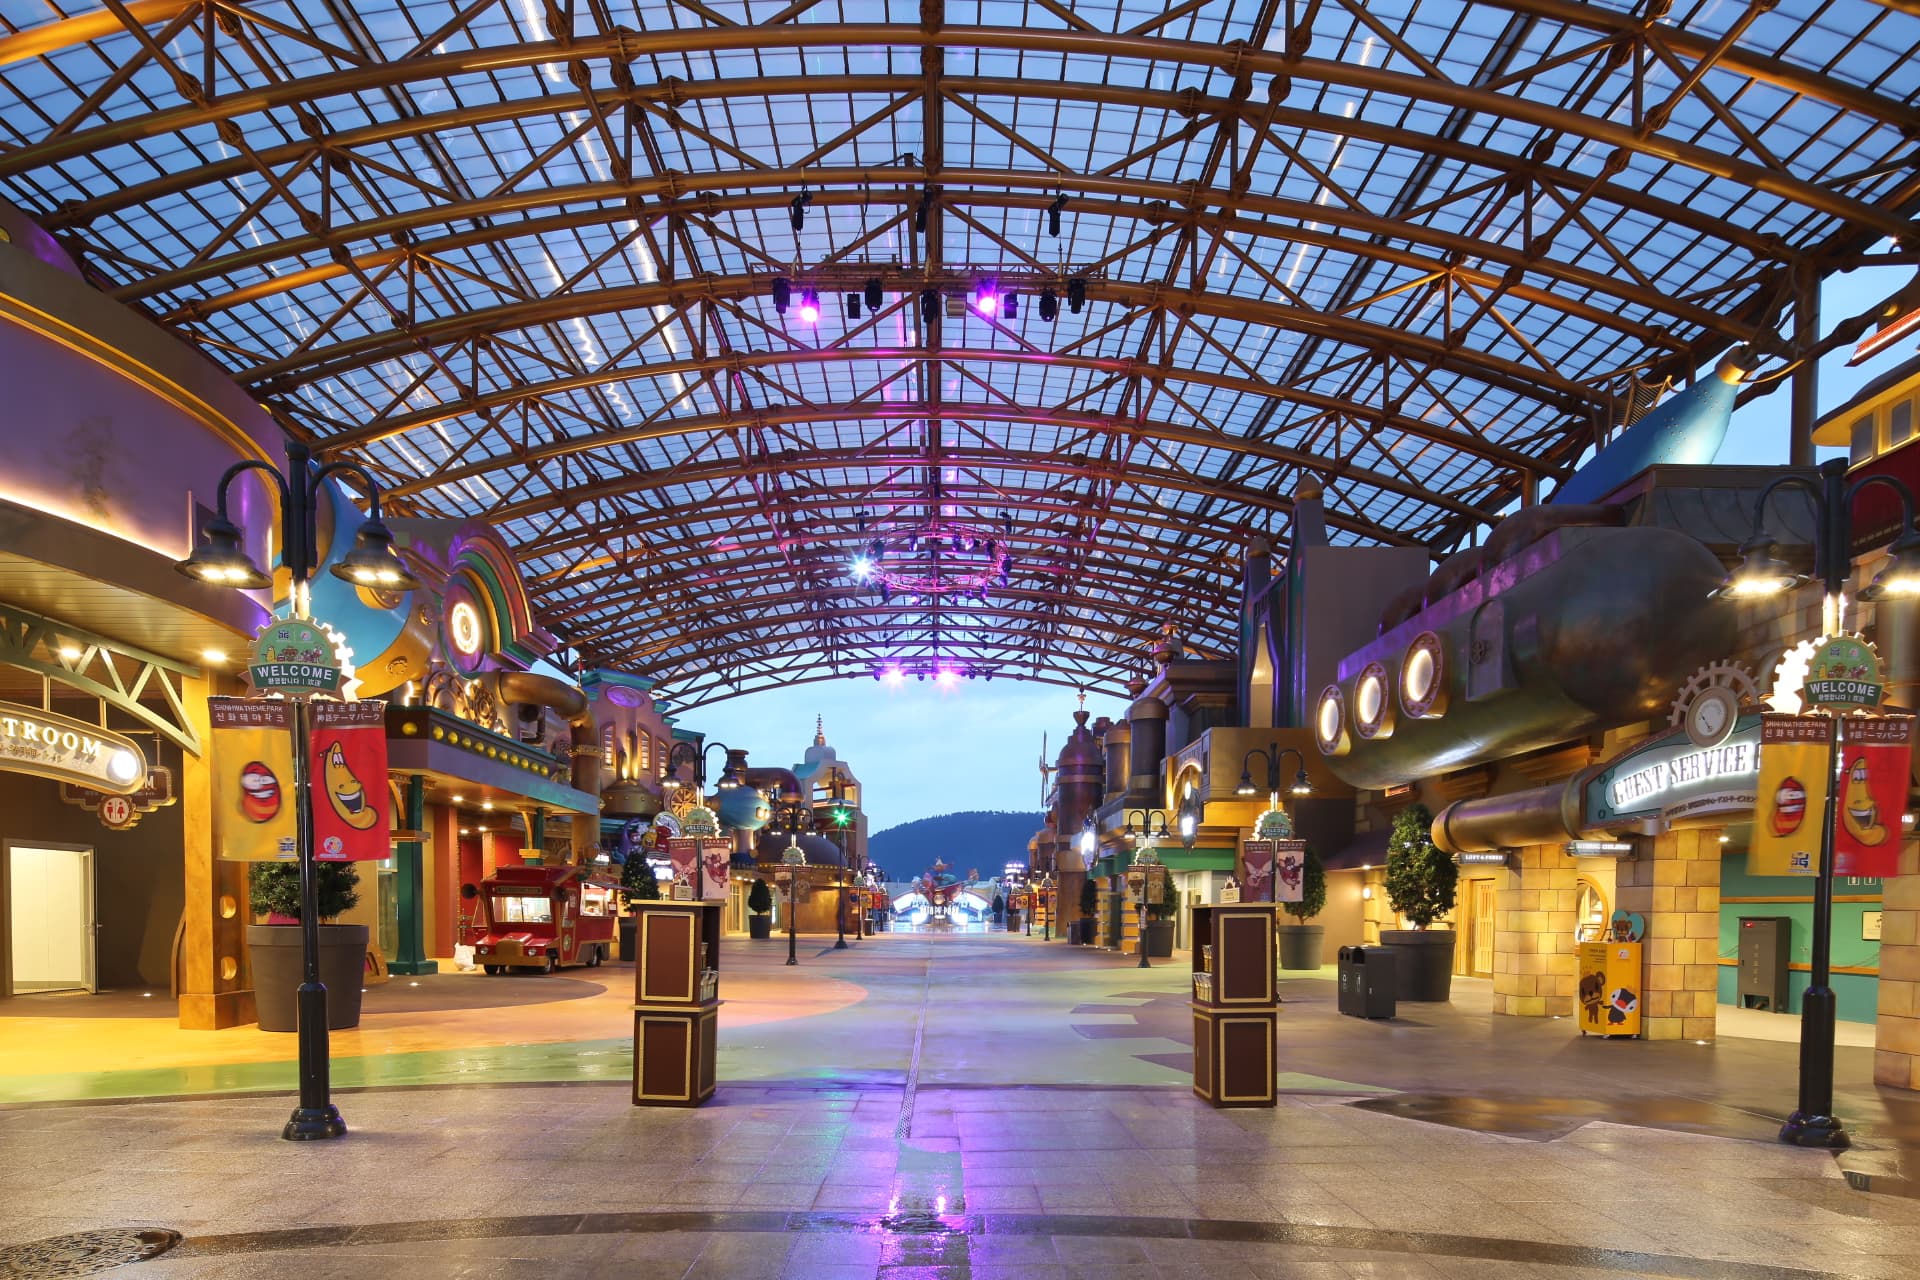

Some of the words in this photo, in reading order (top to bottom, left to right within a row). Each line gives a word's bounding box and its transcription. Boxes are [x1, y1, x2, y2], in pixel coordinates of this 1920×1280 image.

[257, 665, 332, 681] WELCOME
[1810, 682, 1877, 697] WELCOME
[1613, 764, 1664, 806] GUEST
[1668, 744, 1748, 786] SERVICE
